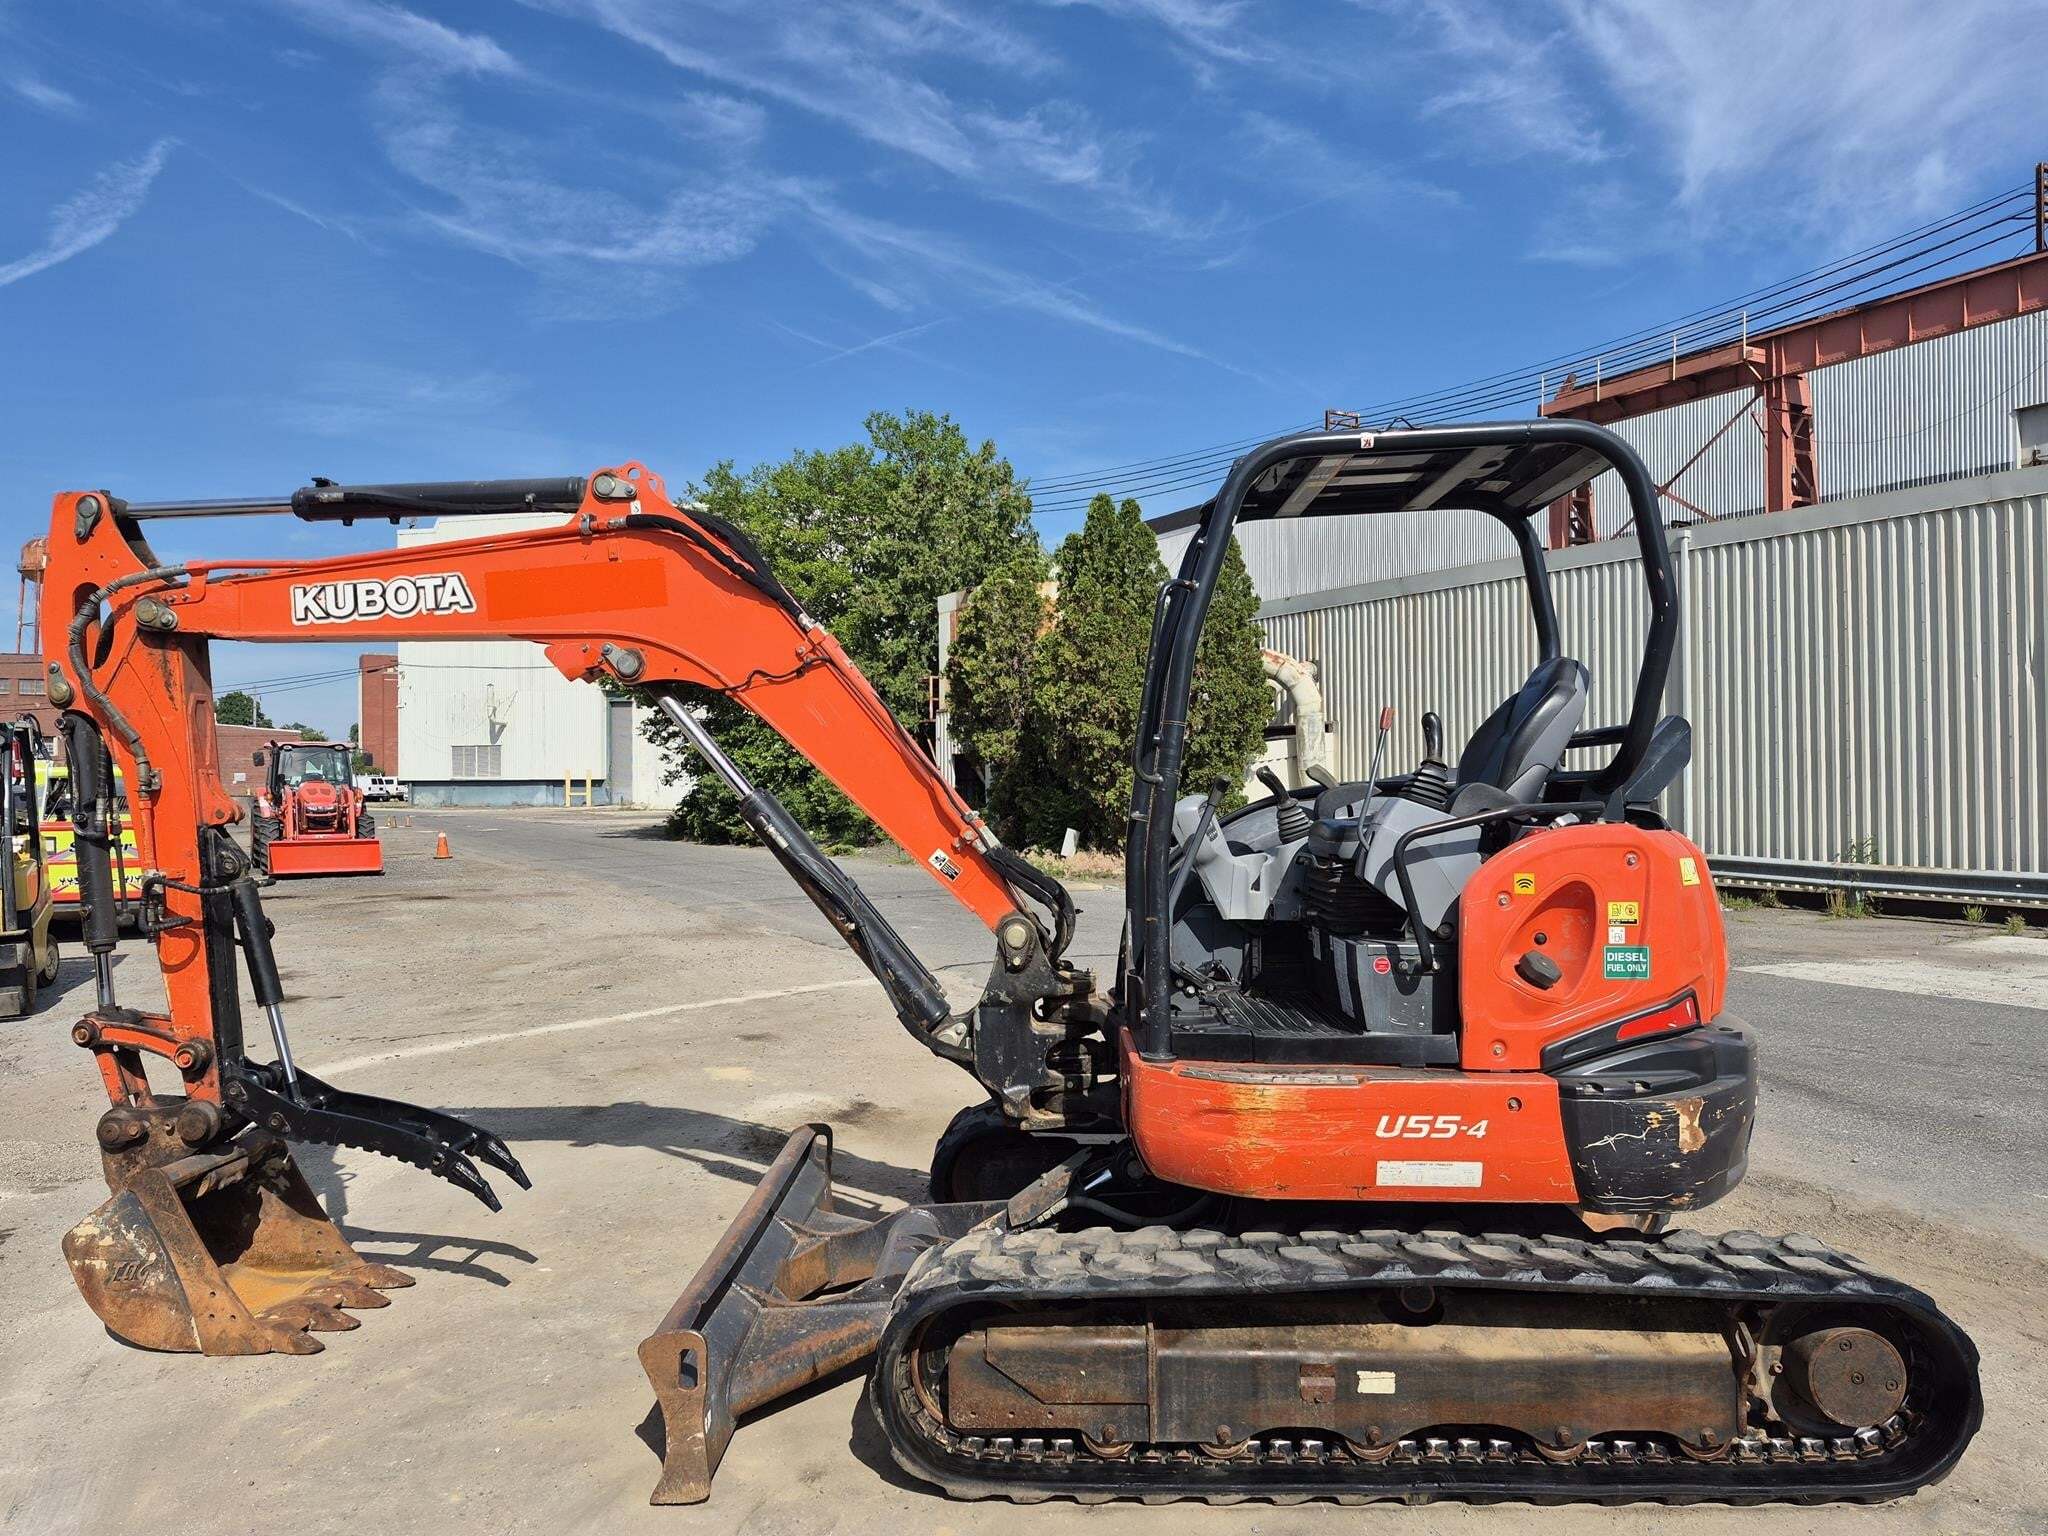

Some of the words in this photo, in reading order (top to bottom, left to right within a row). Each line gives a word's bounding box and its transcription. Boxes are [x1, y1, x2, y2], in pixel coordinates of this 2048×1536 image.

[293, 574, 474, 621] KUBOTA
[1606, 952, 1647, 962] DIESEL
[1606, 963, 1626, 972] FUEL
[1627, 963, 1647, 972] ONLY
[1375, 1115, 1489, 1139] U55-4
